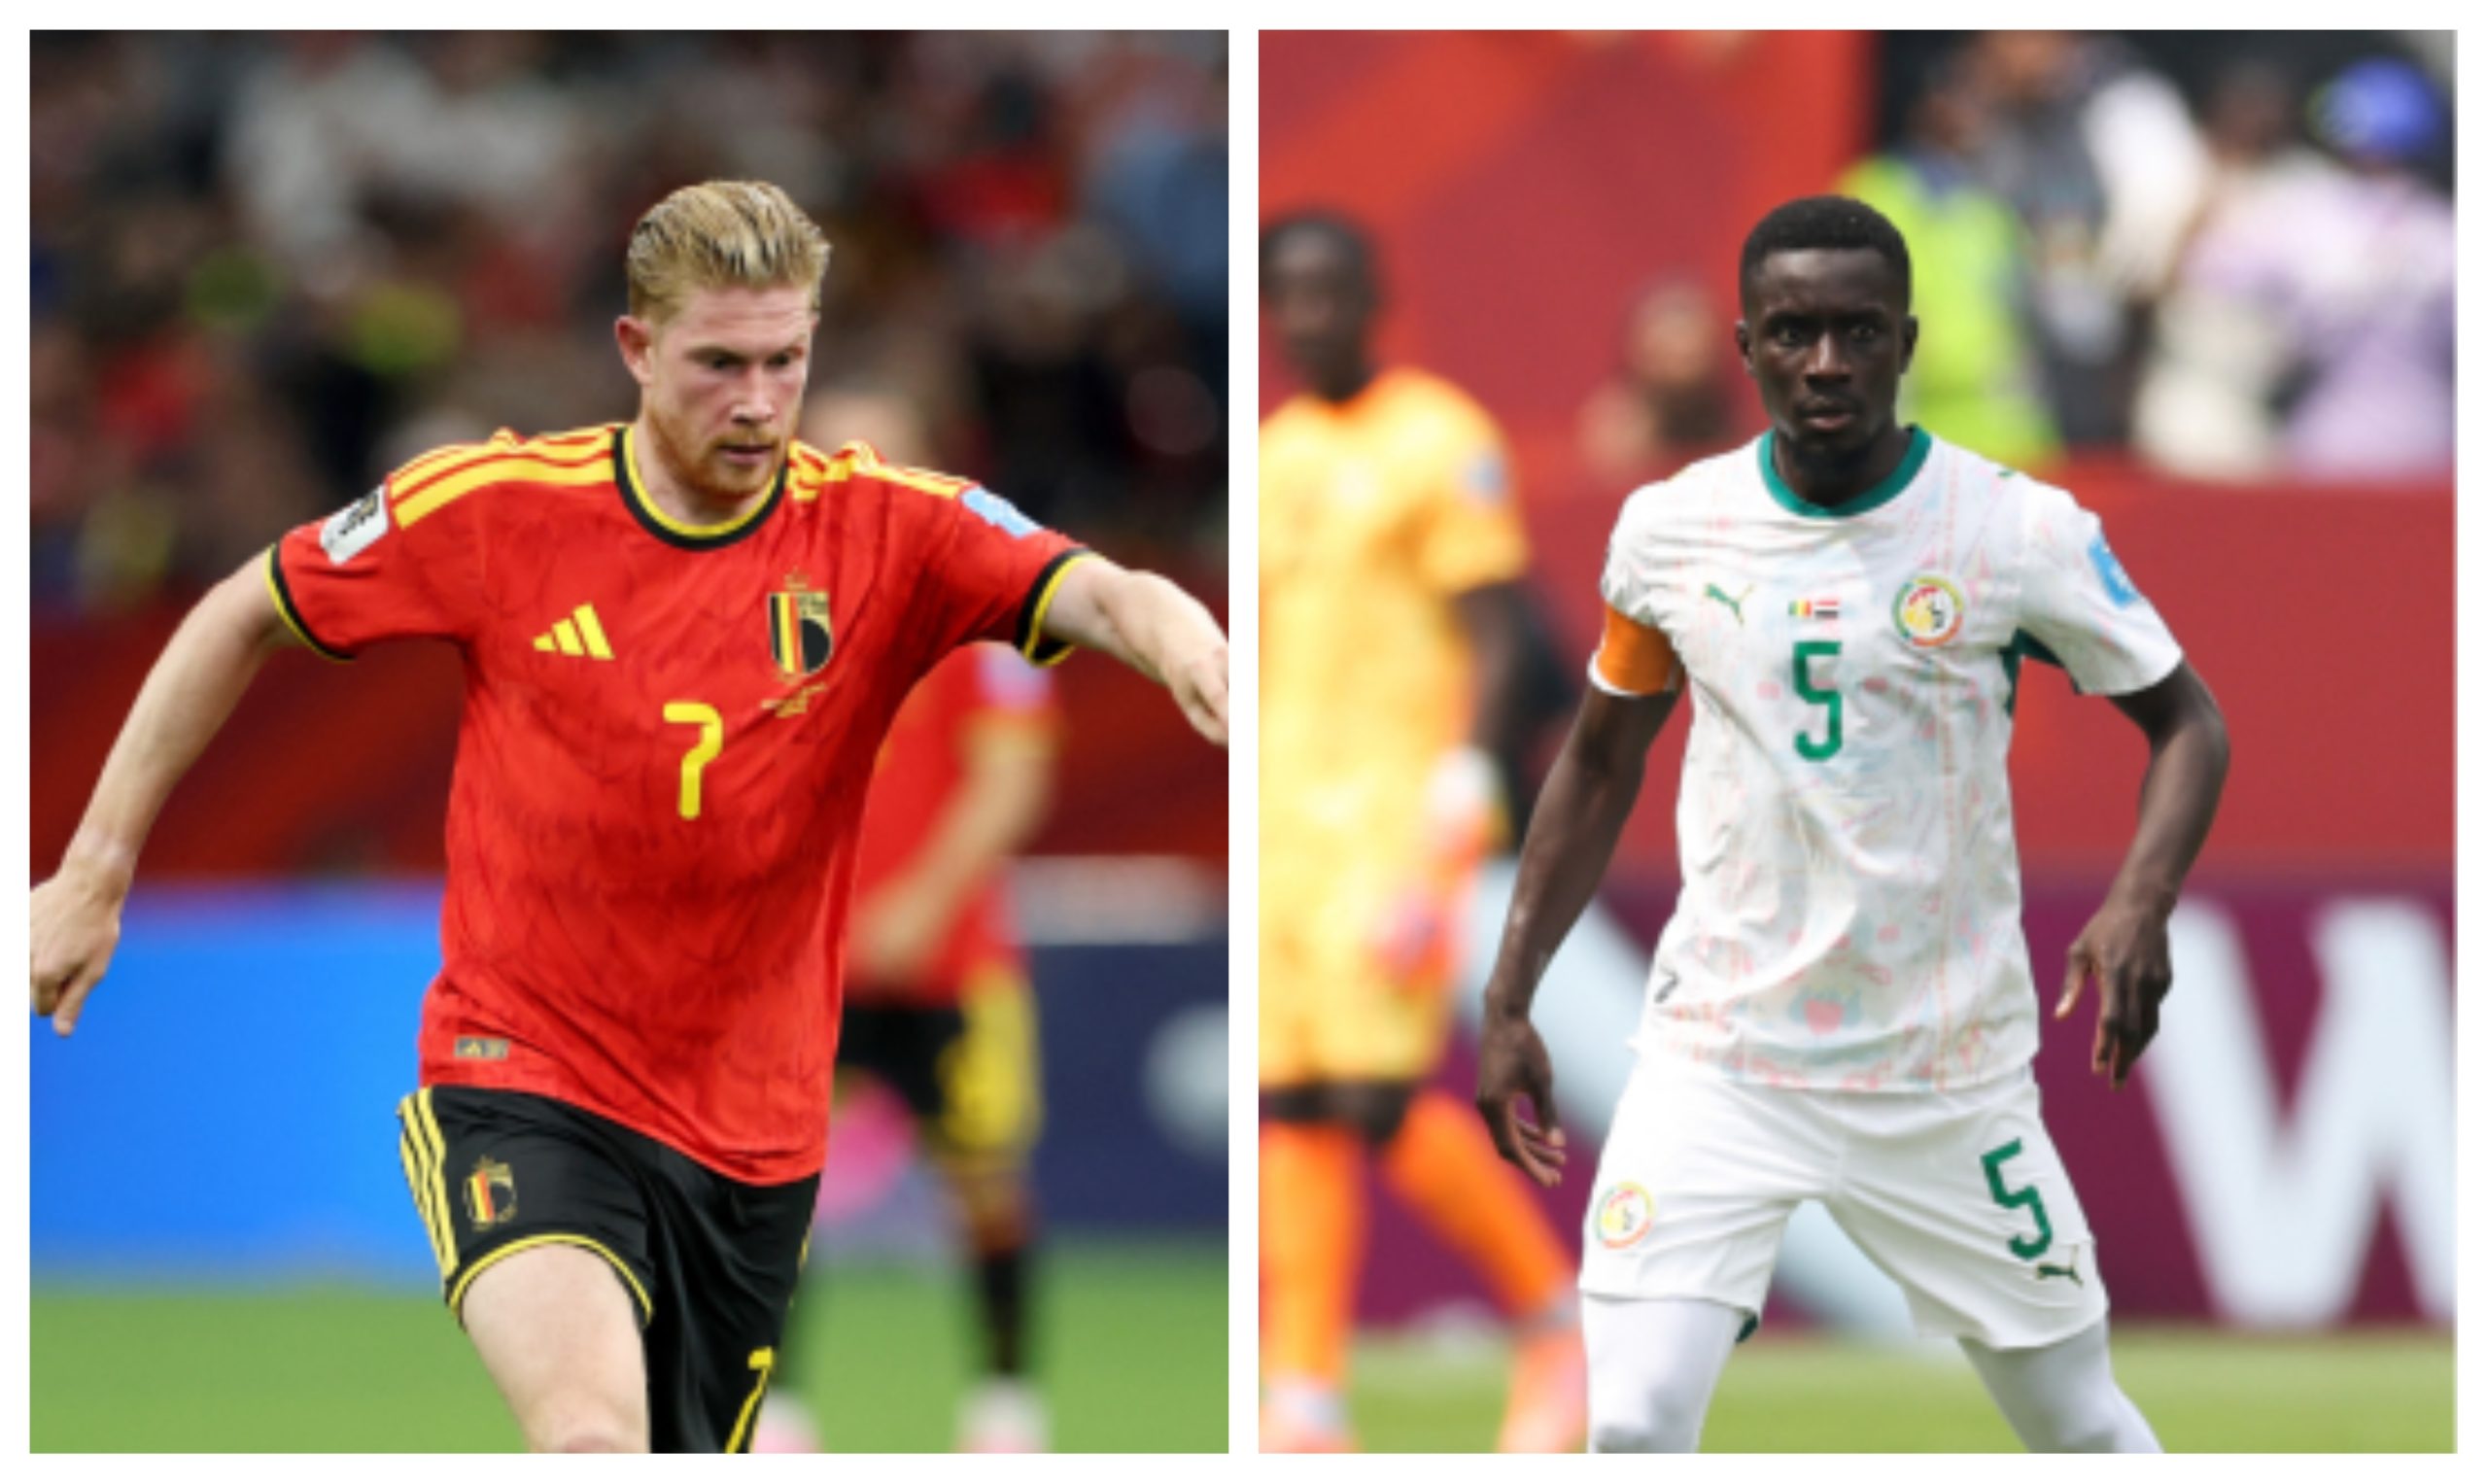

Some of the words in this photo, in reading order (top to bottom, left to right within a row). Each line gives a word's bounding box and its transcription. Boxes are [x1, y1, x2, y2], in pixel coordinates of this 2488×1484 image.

[663, 702, 724, 819] 7
[1792, 640, 1843, 762] 5
[1980, 1138, 2054, 1260] 5
